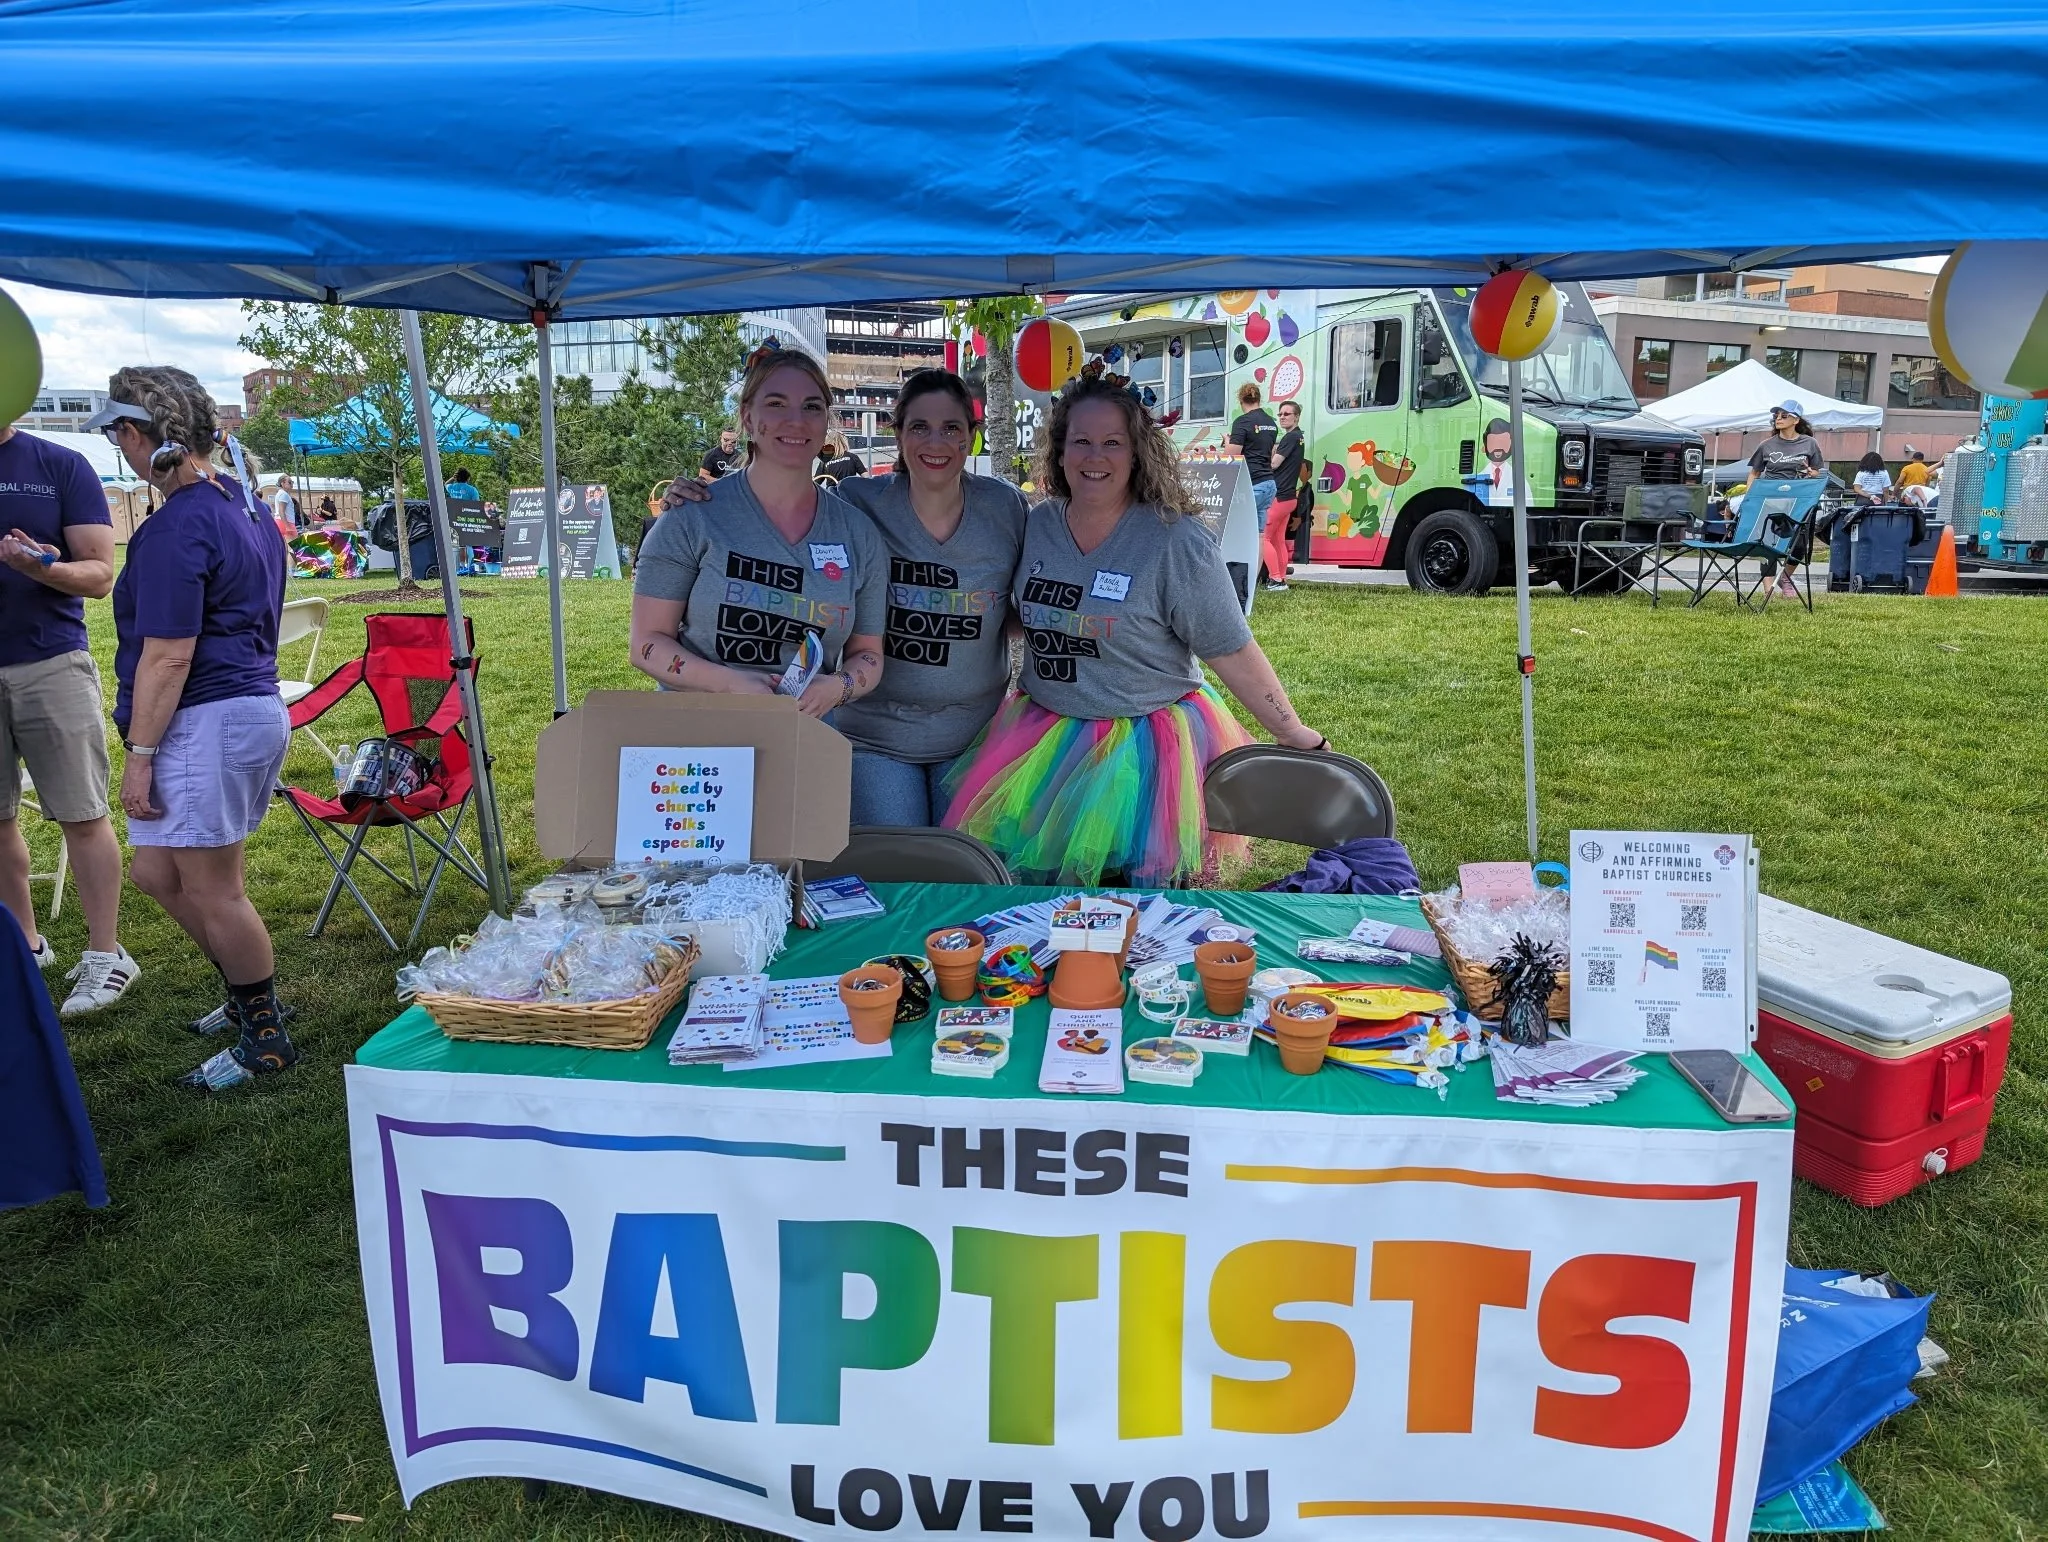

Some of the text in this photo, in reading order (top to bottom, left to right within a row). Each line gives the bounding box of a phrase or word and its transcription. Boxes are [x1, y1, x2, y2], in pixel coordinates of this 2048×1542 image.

[1528, 295, 1540, 321] awab
[24, 483, 56, 495] PRIDE
[510, 508, 545, 518] Pride Month
[514, 497, 544, 514] Celebrate
[731, 554, 799, 590] THIS
[893, 559, 955, 587] THIS
[894, 586, 999, 615] BAPTIST
[1029, 580, 1080, 608] THIS
[725, 581, 849, 629] BAPTIST
[890, 612, 980, 639] LOVES
[1022, 604, 1119, 639] BAPTIST
[719, 637, 777, 663] YOU
[885, 637, 945, 664] YOU
[1024, 630, 1096, 657] LOVES
[656, 763, 720, 777] Cookies
[650, 781, 723, 799] baked by
[655, 799, 716, 813] church
[664, 817, 706, 831] folks
[642, 835, 725, 854] especially
[1624, 842, 1690, 854] WELCOMING
[1612, 855, 1702, 868] AND AFFIRMING
[1602, 869, 1713, 882] BAPTIST CHURCHES
[1057, 919, 1117, 927] LOVED
[767, 984, 808, 992] ookies
[791, 987, 837, 996] church
[945, 1009, 1006, 1018] ERES
[763, 1023, 811, 1033] Cookies
[792, 1027, 841, 1036] church
[1183, 1020, 1245, 1034] ERES
[801, 1043, 825, 1051] you
[881, 1122, 1190, 1198] THESE
[422, 1188, 1697, 1450] BAPTISTS
[791, 1464, 1271, 1542] LOVE YOU
